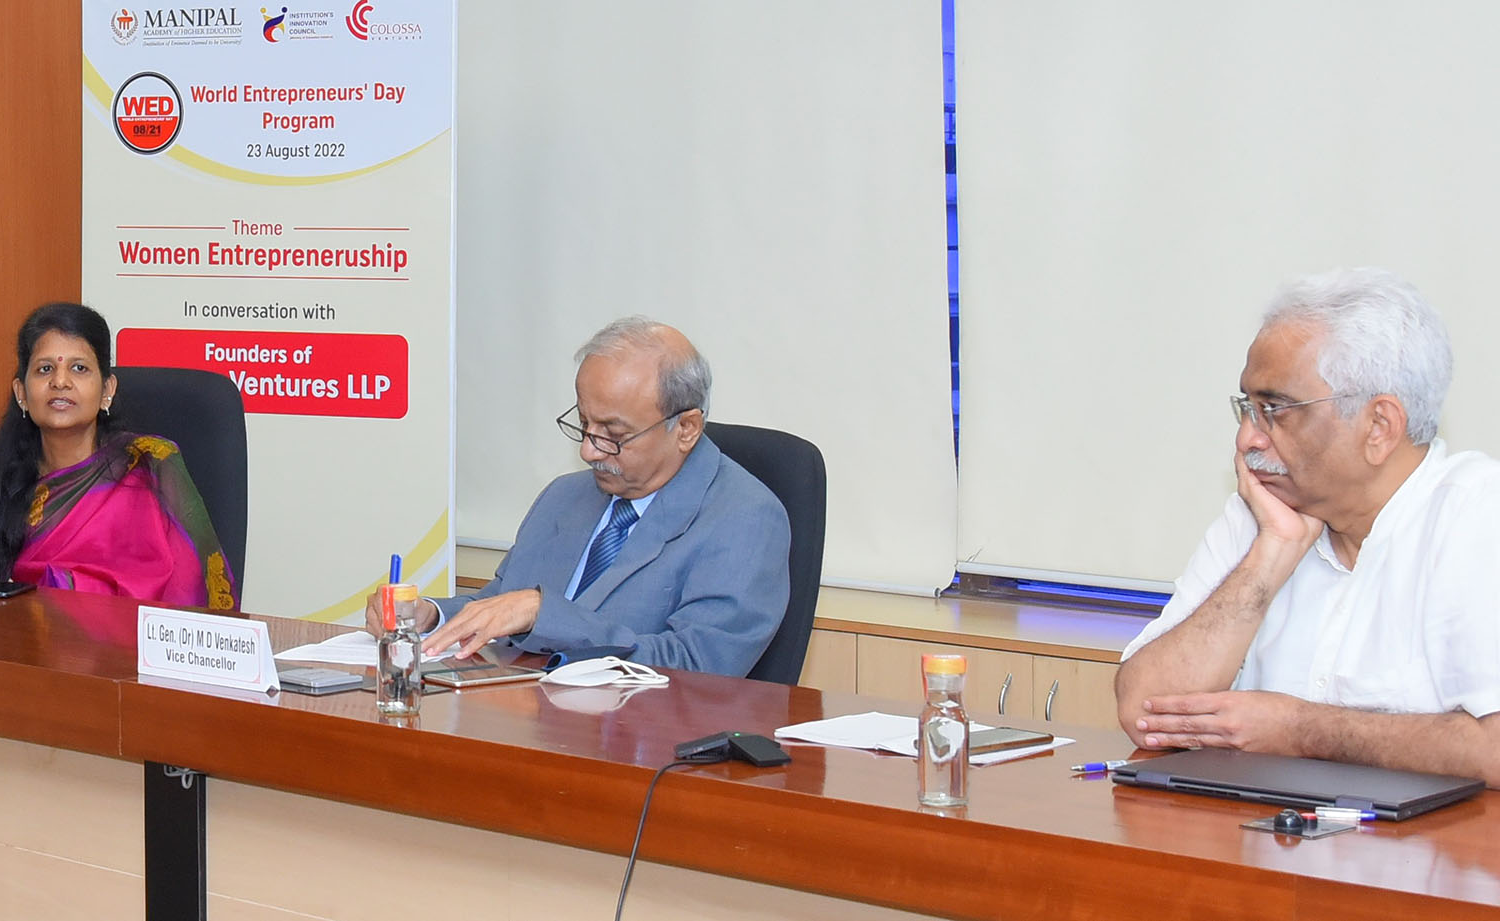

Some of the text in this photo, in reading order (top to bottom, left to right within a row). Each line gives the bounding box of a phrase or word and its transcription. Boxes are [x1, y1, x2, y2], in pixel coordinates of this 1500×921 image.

[143, 8, 242, 28] MANIPAL
[289, 11, 334, 19] INSTITUTION'S
[143, 28, 172, 36] ACADEMY
[181, 28, 205, 36] HIGHER
[206, 27, 242, 35] EDUCATION
[370, 23, 422, 35] COLOSSA
[190, 83, 406, 106] World Entrepreneurs' Day
[122, 96, 175, 116] WED
[133, 125, 161, 135] 08/21
[262, 113, 335, 133] Program
[246, 144, 345, 161] 23 August 2022
[232, 220, 283, 236] Theme
[119, 241, 408, 273] Women Entrepreneruship
[184, 302, 336, 321] In conversation with
[205, 343, 312, 365] Founders of
[228, 370, 391, 400] Ventures LLP
[147, 623, 256, 656] Lt. Gen. (Dr) M D Venkatesh
[165, 648, 237, 672] Vice Chancellor
